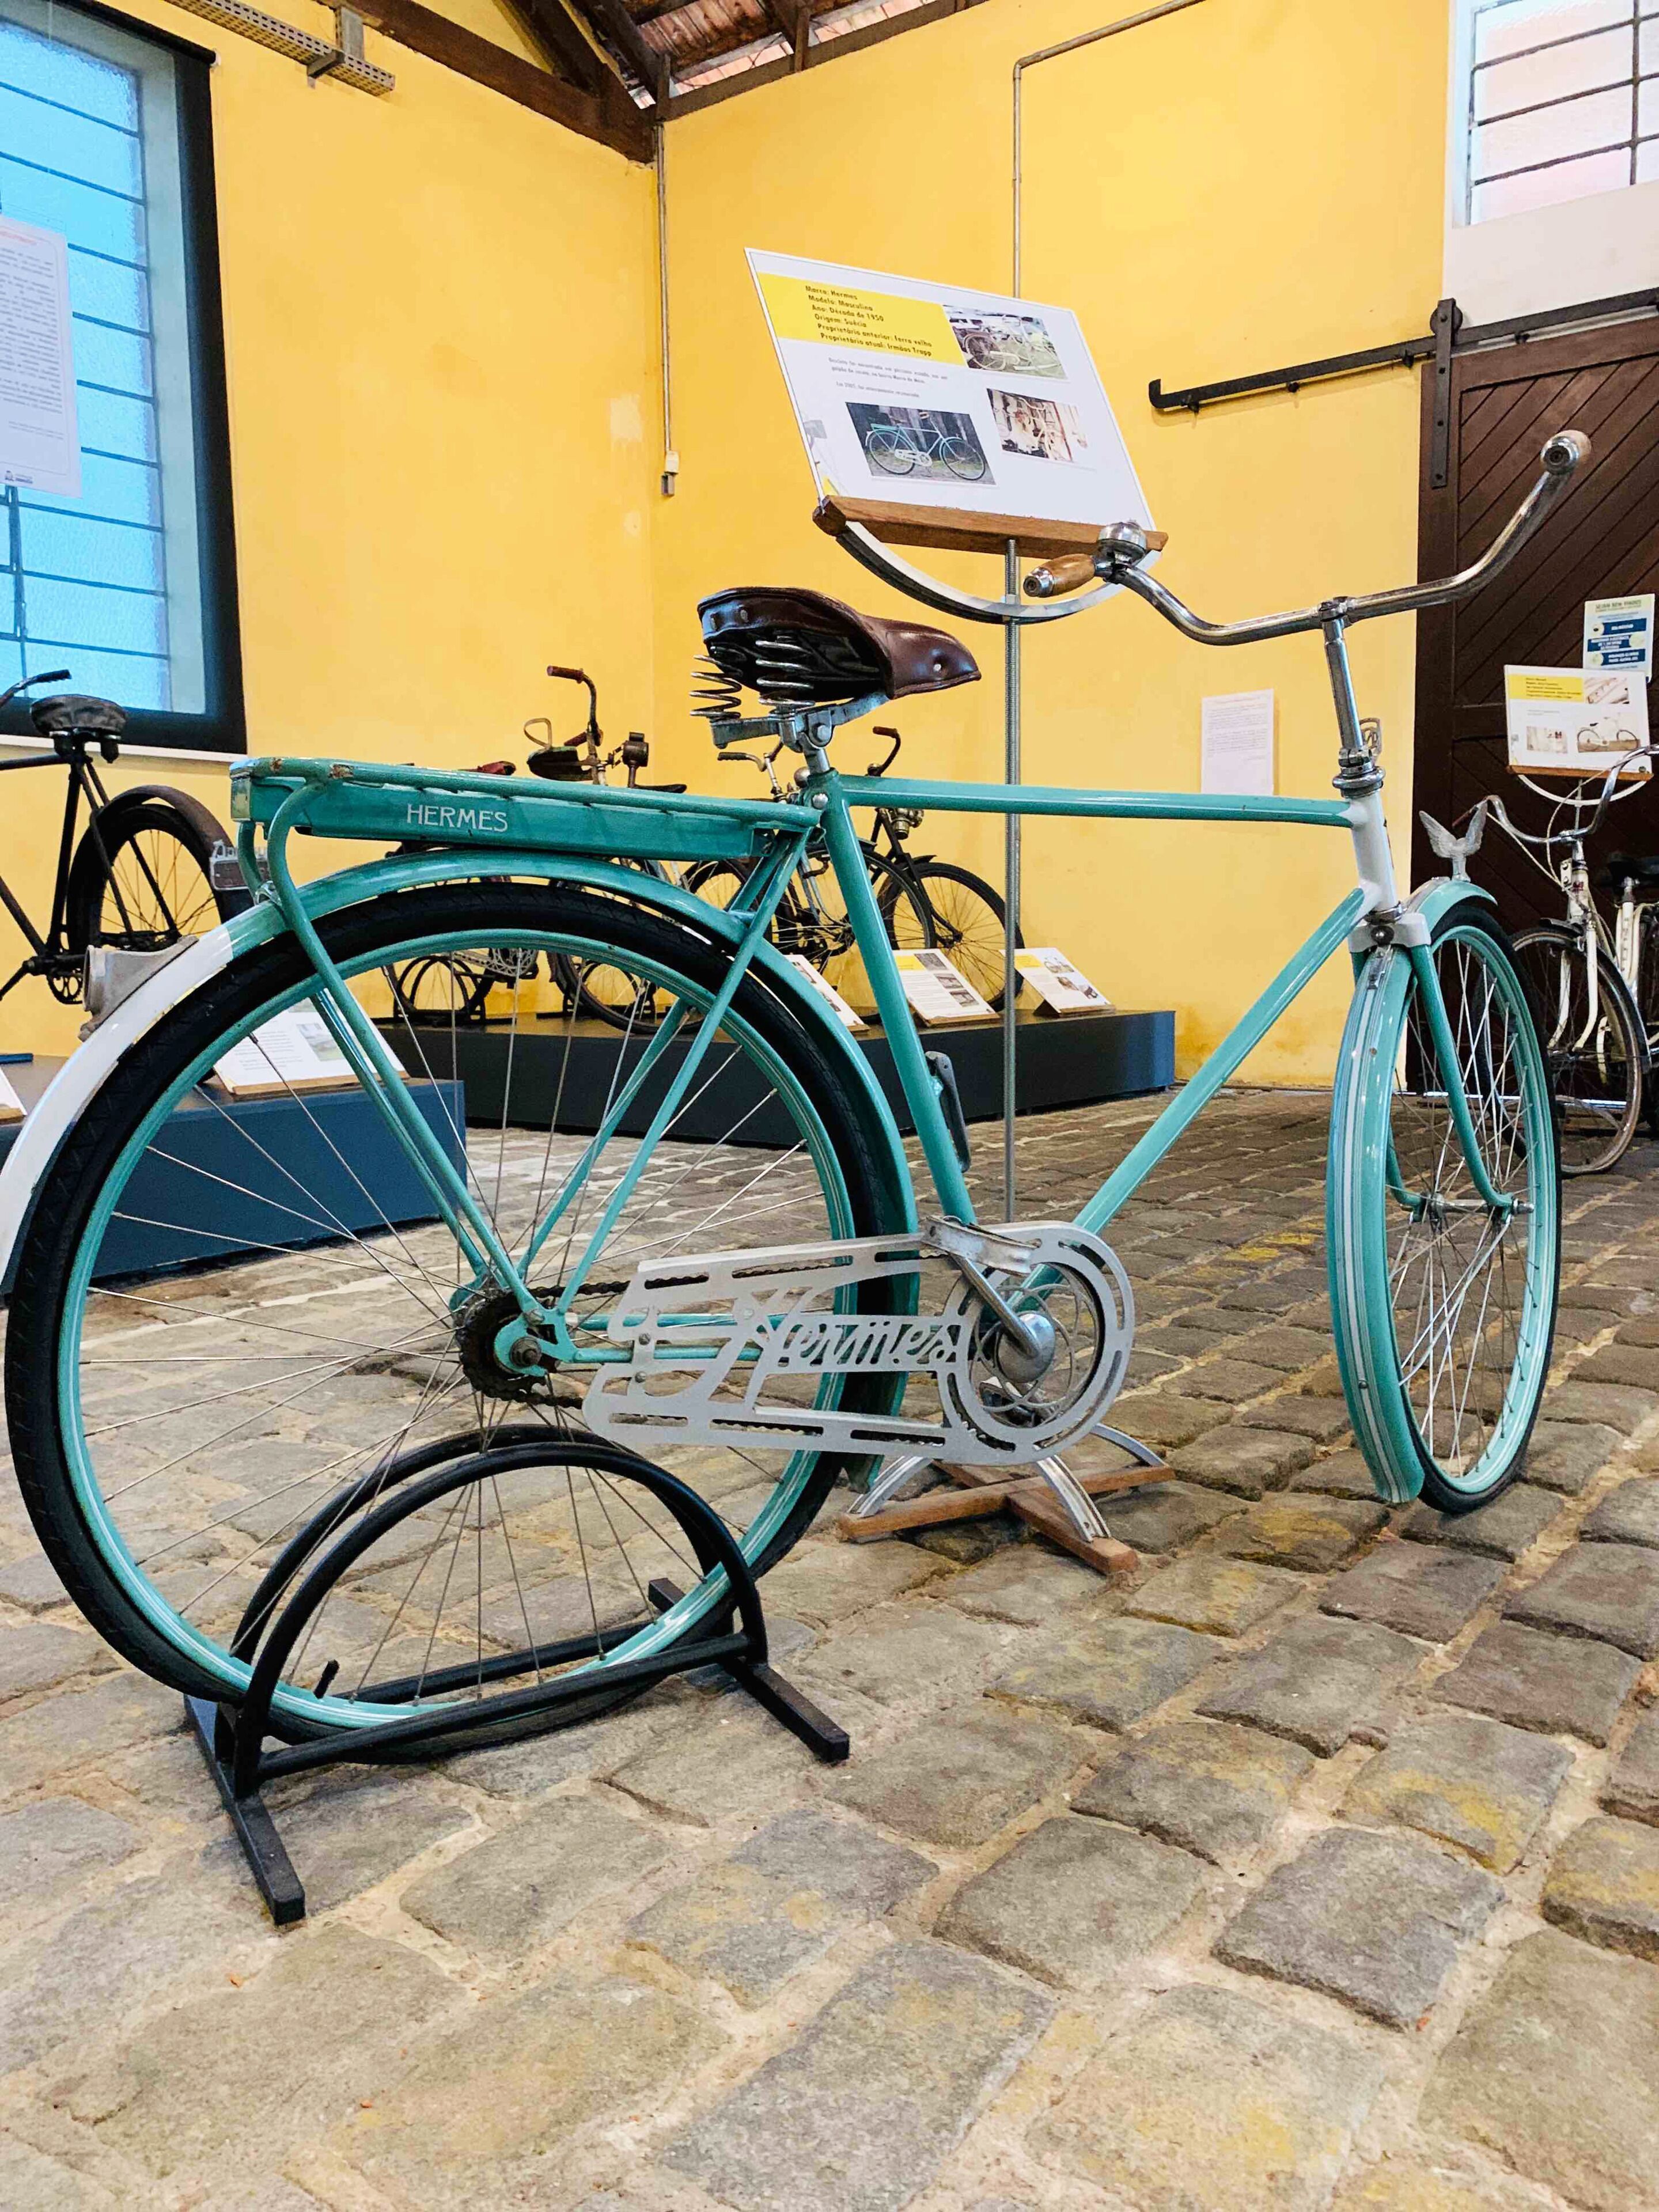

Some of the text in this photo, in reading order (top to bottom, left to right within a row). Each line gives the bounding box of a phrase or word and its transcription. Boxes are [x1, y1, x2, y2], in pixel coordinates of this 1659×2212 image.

[808, 295, 836, 304] Modelo:
[831, 290, 857, 300] Hermes
[866, 313, 884, 321] 1950
[407, 804, 508, 832] HERMES
